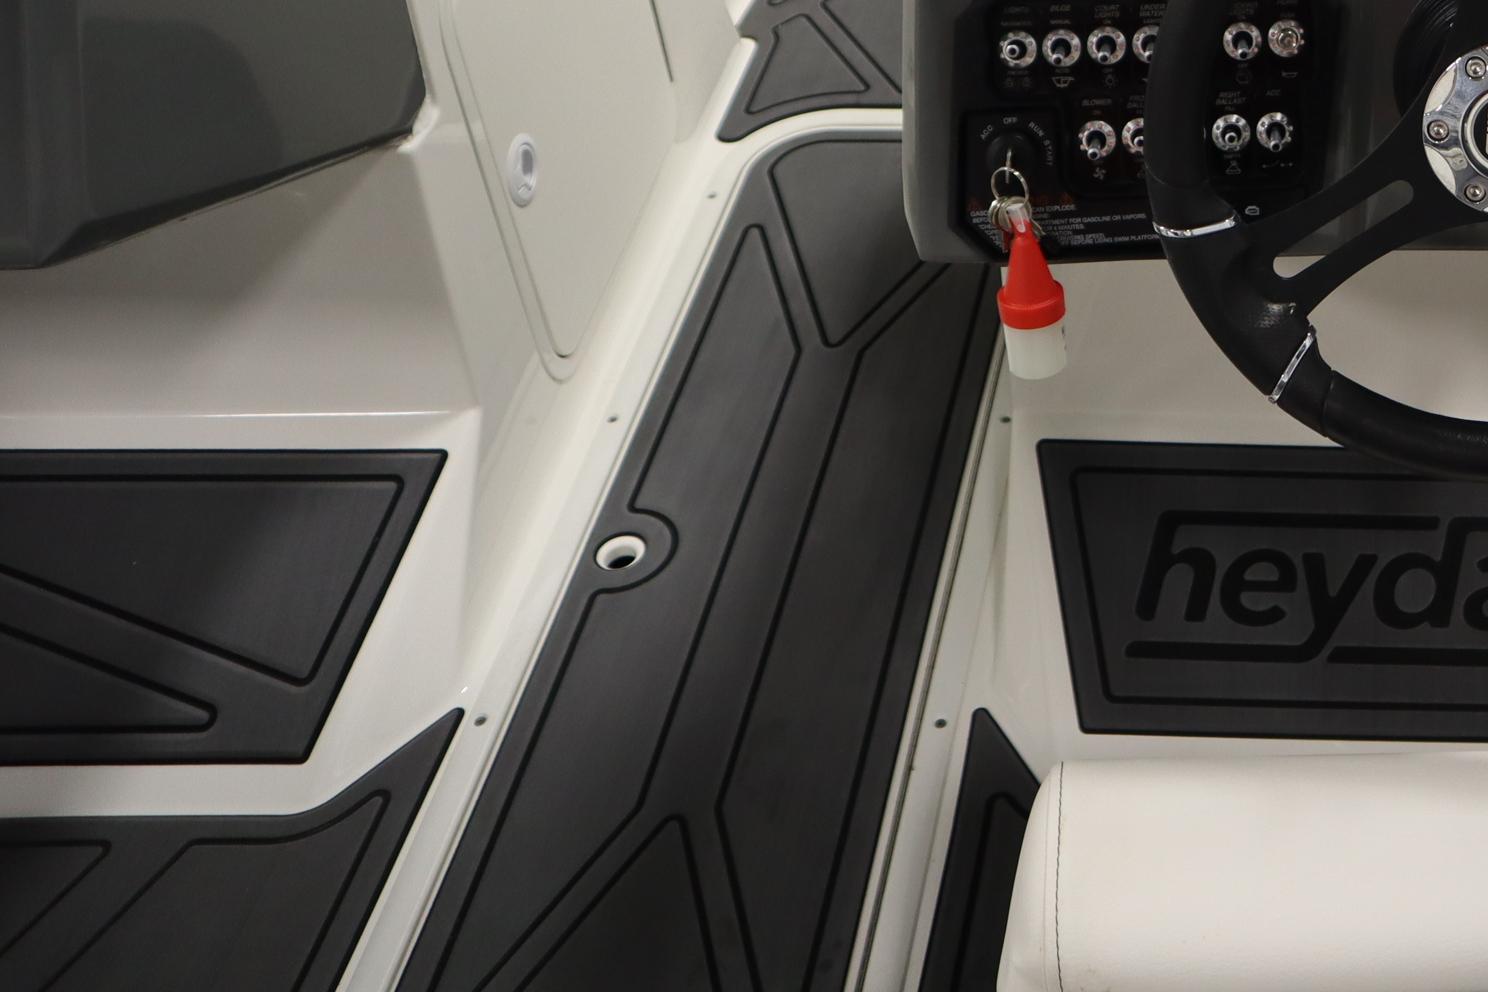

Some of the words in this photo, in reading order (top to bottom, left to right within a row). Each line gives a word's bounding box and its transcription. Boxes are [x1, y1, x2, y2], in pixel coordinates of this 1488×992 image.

[1003, 116, 1018, 125] OFF
[980, 124, 994, 140] ACC
[1028, 121, 1045, 137] RUN
